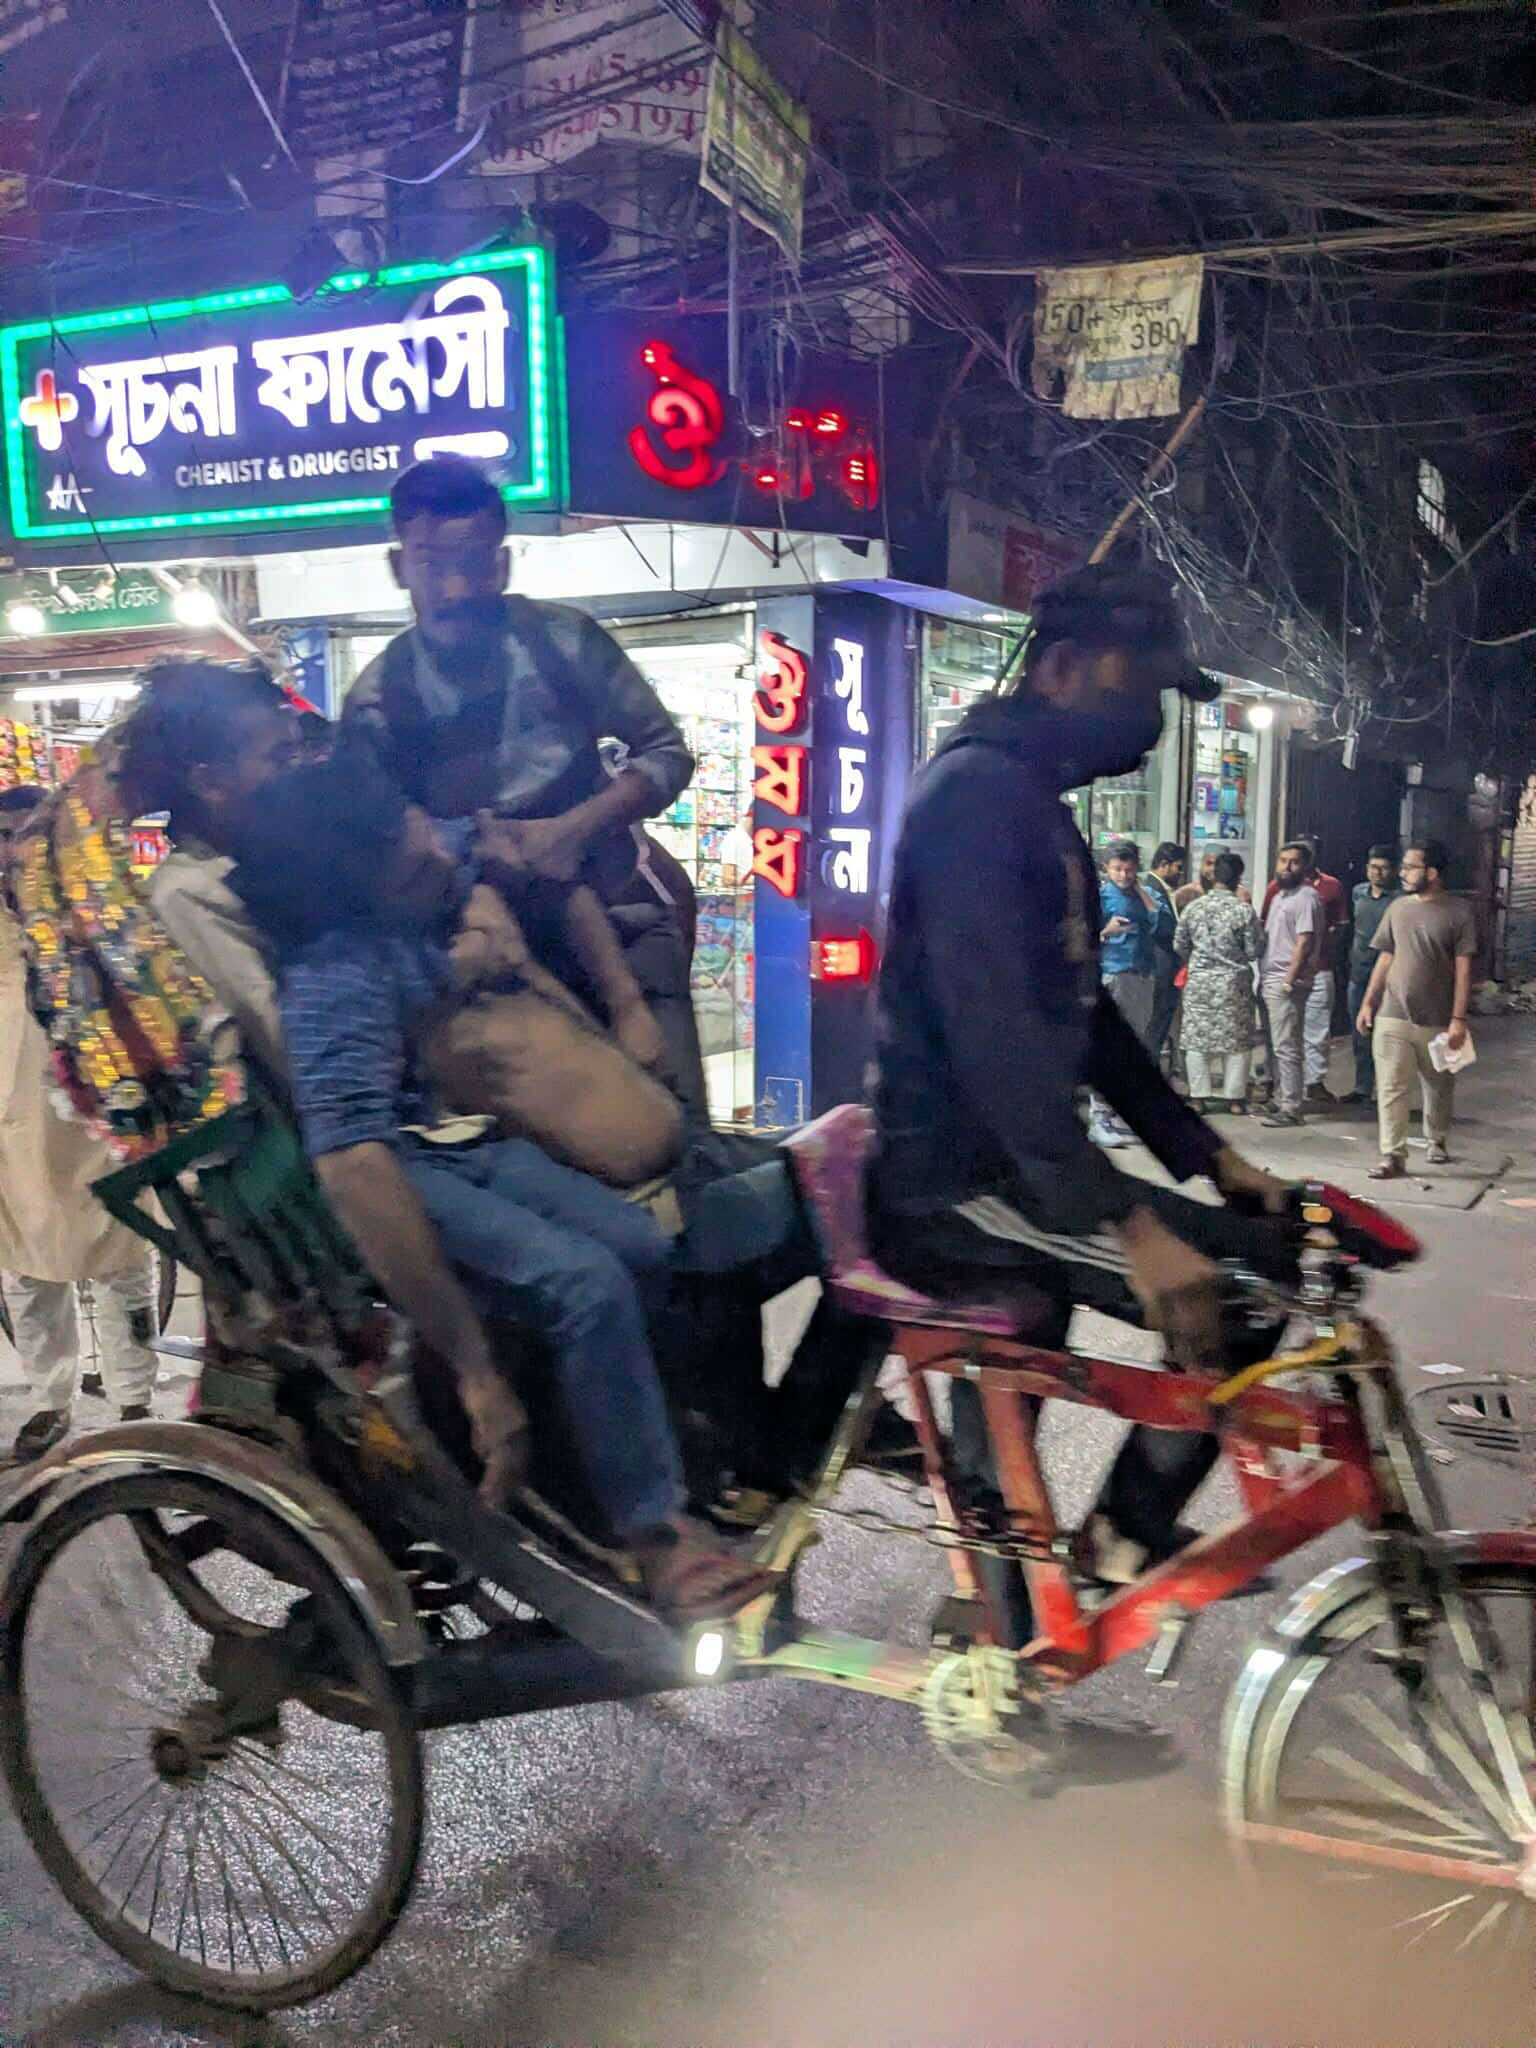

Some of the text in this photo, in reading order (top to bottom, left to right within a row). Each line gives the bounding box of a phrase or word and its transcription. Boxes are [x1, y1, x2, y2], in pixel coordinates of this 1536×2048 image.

[78, 346, 239, 476] সূচনা
[175, 445, 401, 488] CHEMIST & DRUGGIST
[752, 630, 808, 899] ঔষধ
[831, 637, 871, 895] সূচনা
